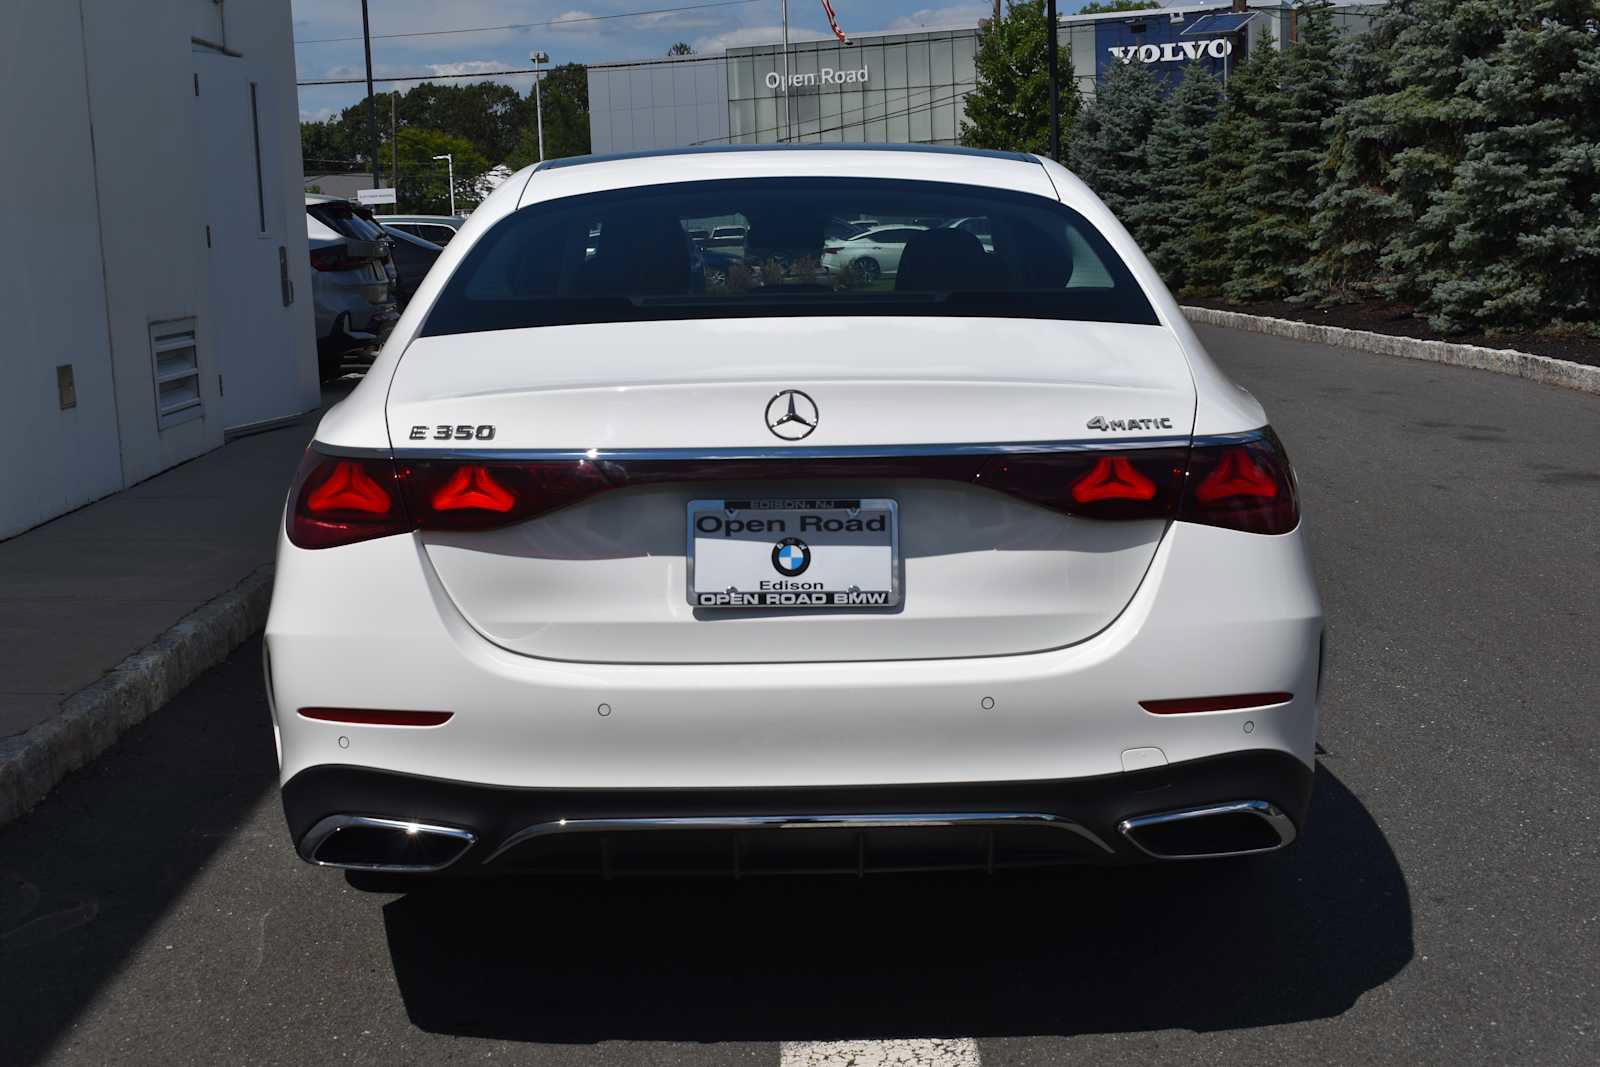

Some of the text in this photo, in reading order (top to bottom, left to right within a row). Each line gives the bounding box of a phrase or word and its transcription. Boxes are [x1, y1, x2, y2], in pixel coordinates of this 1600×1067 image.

[1108, 38, 1232, 64] VOLVO
[765, 64, 868, 92] Open Road
[1086, 416, 1173, 431] 4MATIC
[409, 425, 496, 440] E 350
[696, 515, 886, 536] Open Road
[760, 580, 824, 591] Edison
[700, 594, 886, 605] OPEN ROAD BMW
